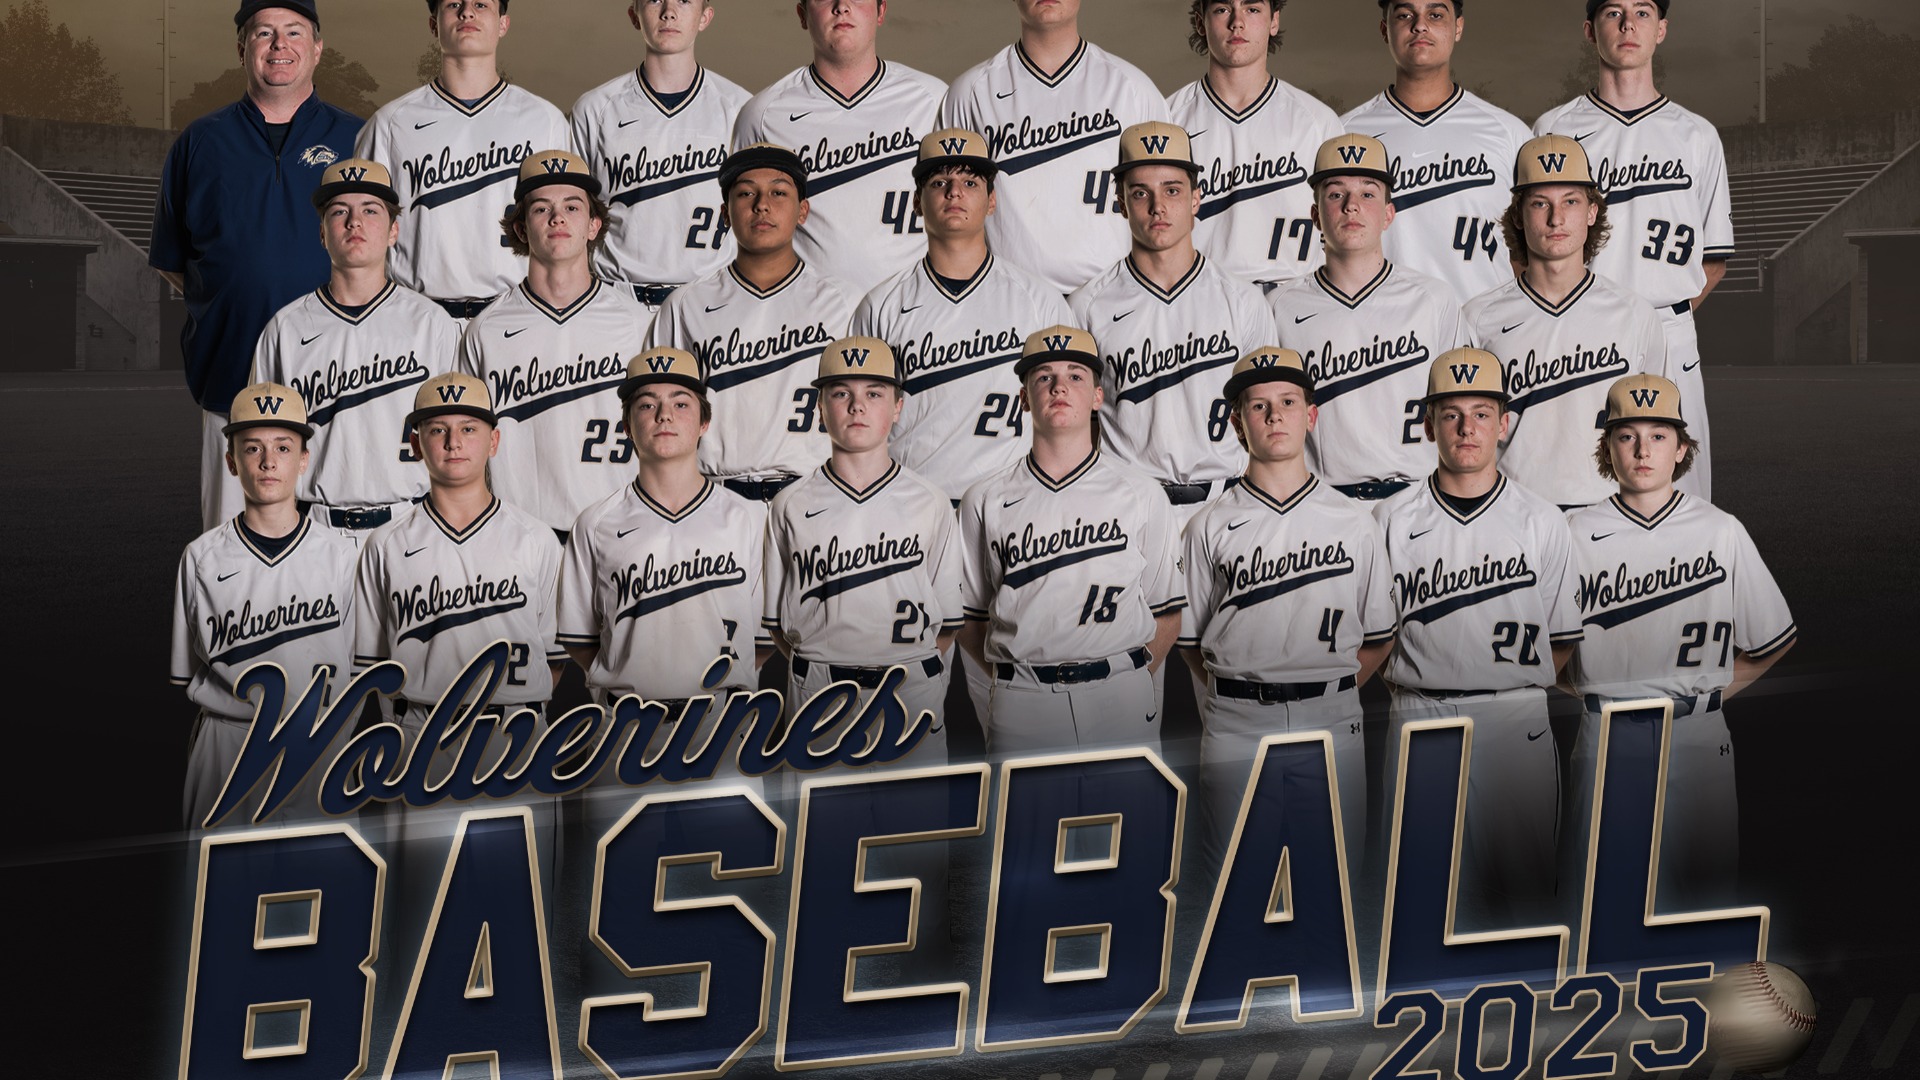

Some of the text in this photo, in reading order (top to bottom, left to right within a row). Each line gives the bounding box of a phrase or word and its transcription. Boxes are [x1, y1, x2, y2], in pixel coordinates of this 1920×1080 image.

[797, 126, 915, 176] olverines
[938, 137, 969, 156] W
[984, 108, 1115, 160] Wolverines
[1140, 135, 1170, 155] W
[1337, 145, 1367, 165] W
[338, 166, 368, 182] W
[541, 157, 569, 174] W
[604, 143, 728, 194] Wolverines
[1197, 151, 1300, 200] olverines
[1390, 152, 1489, 193] lverines
[1537, 153, 1567, 174] W
[1268, 217, 1314, 262] 17
[1641, 218, 1695, 267] 33
[646, 356, 676, 374] W
[693, 322, 827, 380] Wolverines
[841, 348, 870, 368] W
[1043, 335, 1073, 351] W
[1106, 330, 1231, 391] Wolverines
[1250, 354, 1280, 368] W
[291, 351, 419, 411] Wolverines
[436, 385, 467, 404] W
[489, 352, 622, 408] Wolverines
[1450, 364, 1480, 384] W
[254, 396, 285, 415] W
[974, 393, 1023, 437] 24
[1207, 398, 1233, 442] 8
[1629, 389, 1660, 408] W
[581, 419, 635, 463] 23
[793, 532, 920, 590] Wolverines
[991, 518, 1122, 576] Wolverines
[1219, 541, 1347, 596] Wolverines
[611, 548, 737, 609] Wolverines
[1394, 553, 1528, 612] Wolverines
[1580, 550, 1717, 614] Wolverines
[206, 594, 338, 654] Wolverines
[392, 574, 521, 630] Wolverines
[891, 600, 930, 643] 21
[1318, 608, 1344, 652] 4
[1676, 621, 1732, 667] 27
